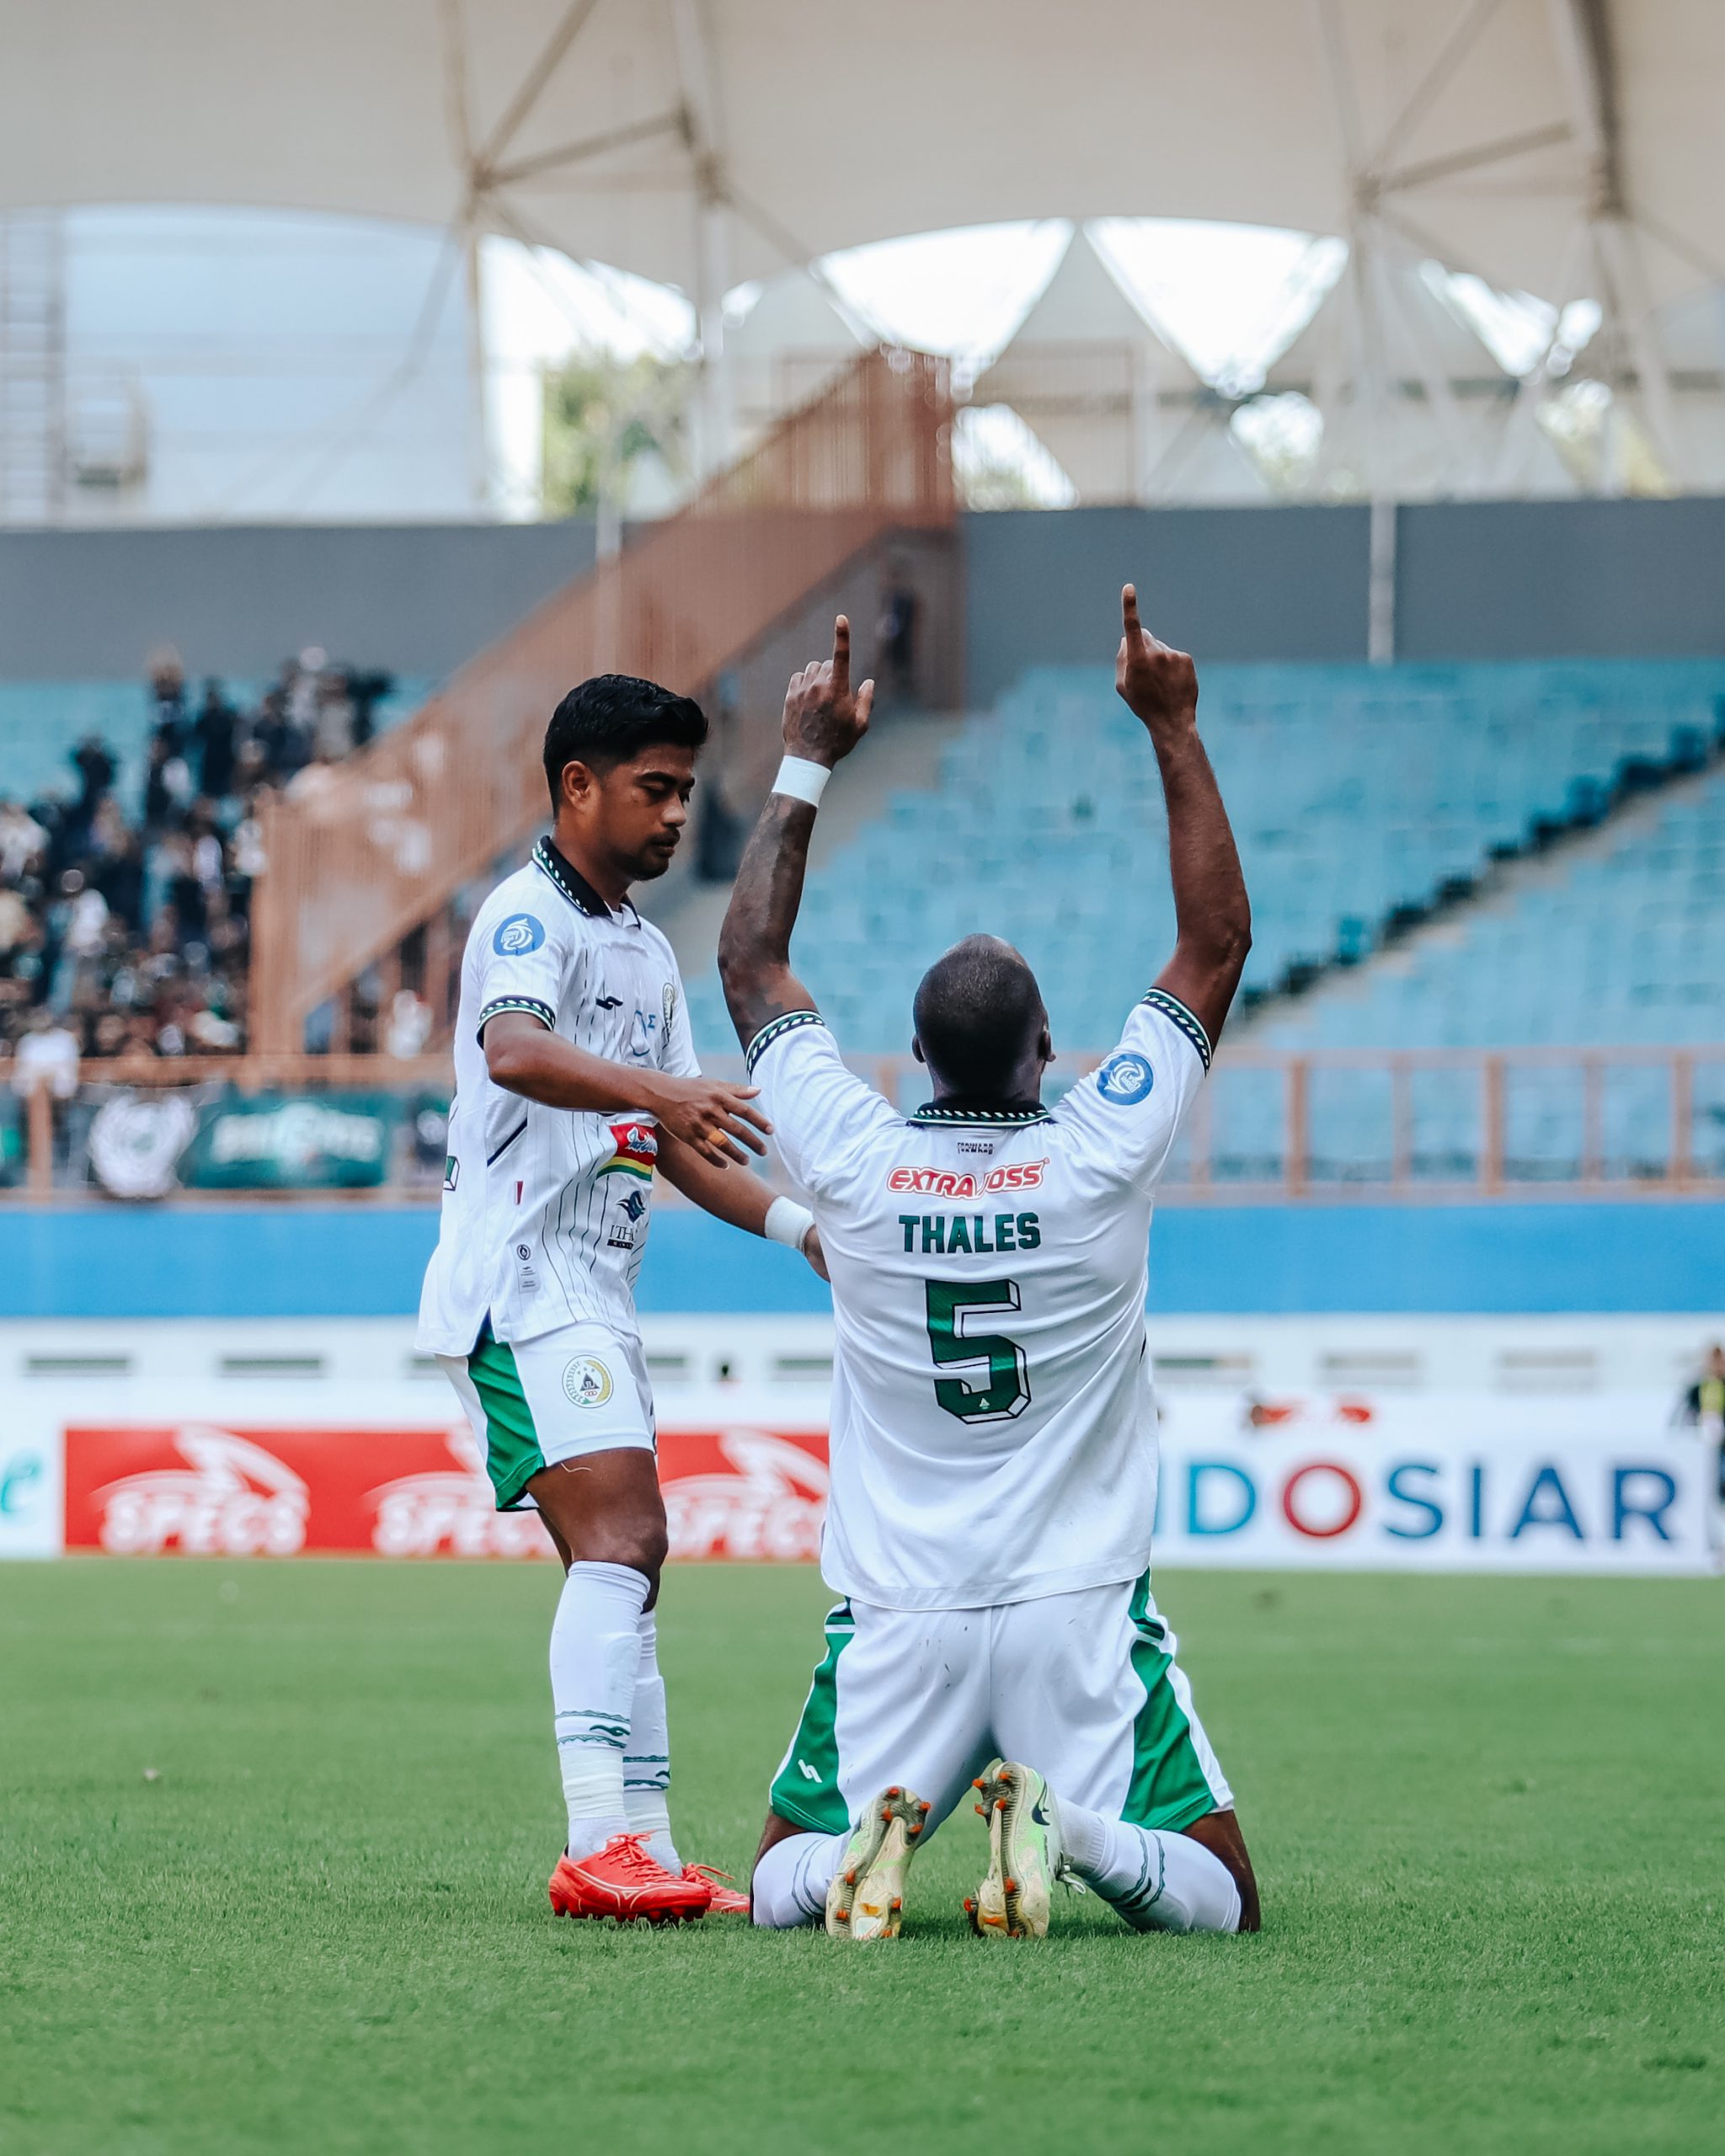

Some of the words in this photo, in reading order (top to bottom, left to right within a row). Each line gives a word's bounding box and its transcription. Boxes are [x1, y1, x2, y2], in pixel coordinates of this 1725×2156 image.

[889, 1169, 974, 1198] EXTRA
[979, 1164, 1043, 1194] OSS
[899, 1212, 1041, 1253] THALES
[925, 1278, 1032, 1425] 5
[99, 1491, 310, 1555] SPECS
[1151, 1464, 1676, 1540] DOSIAR
